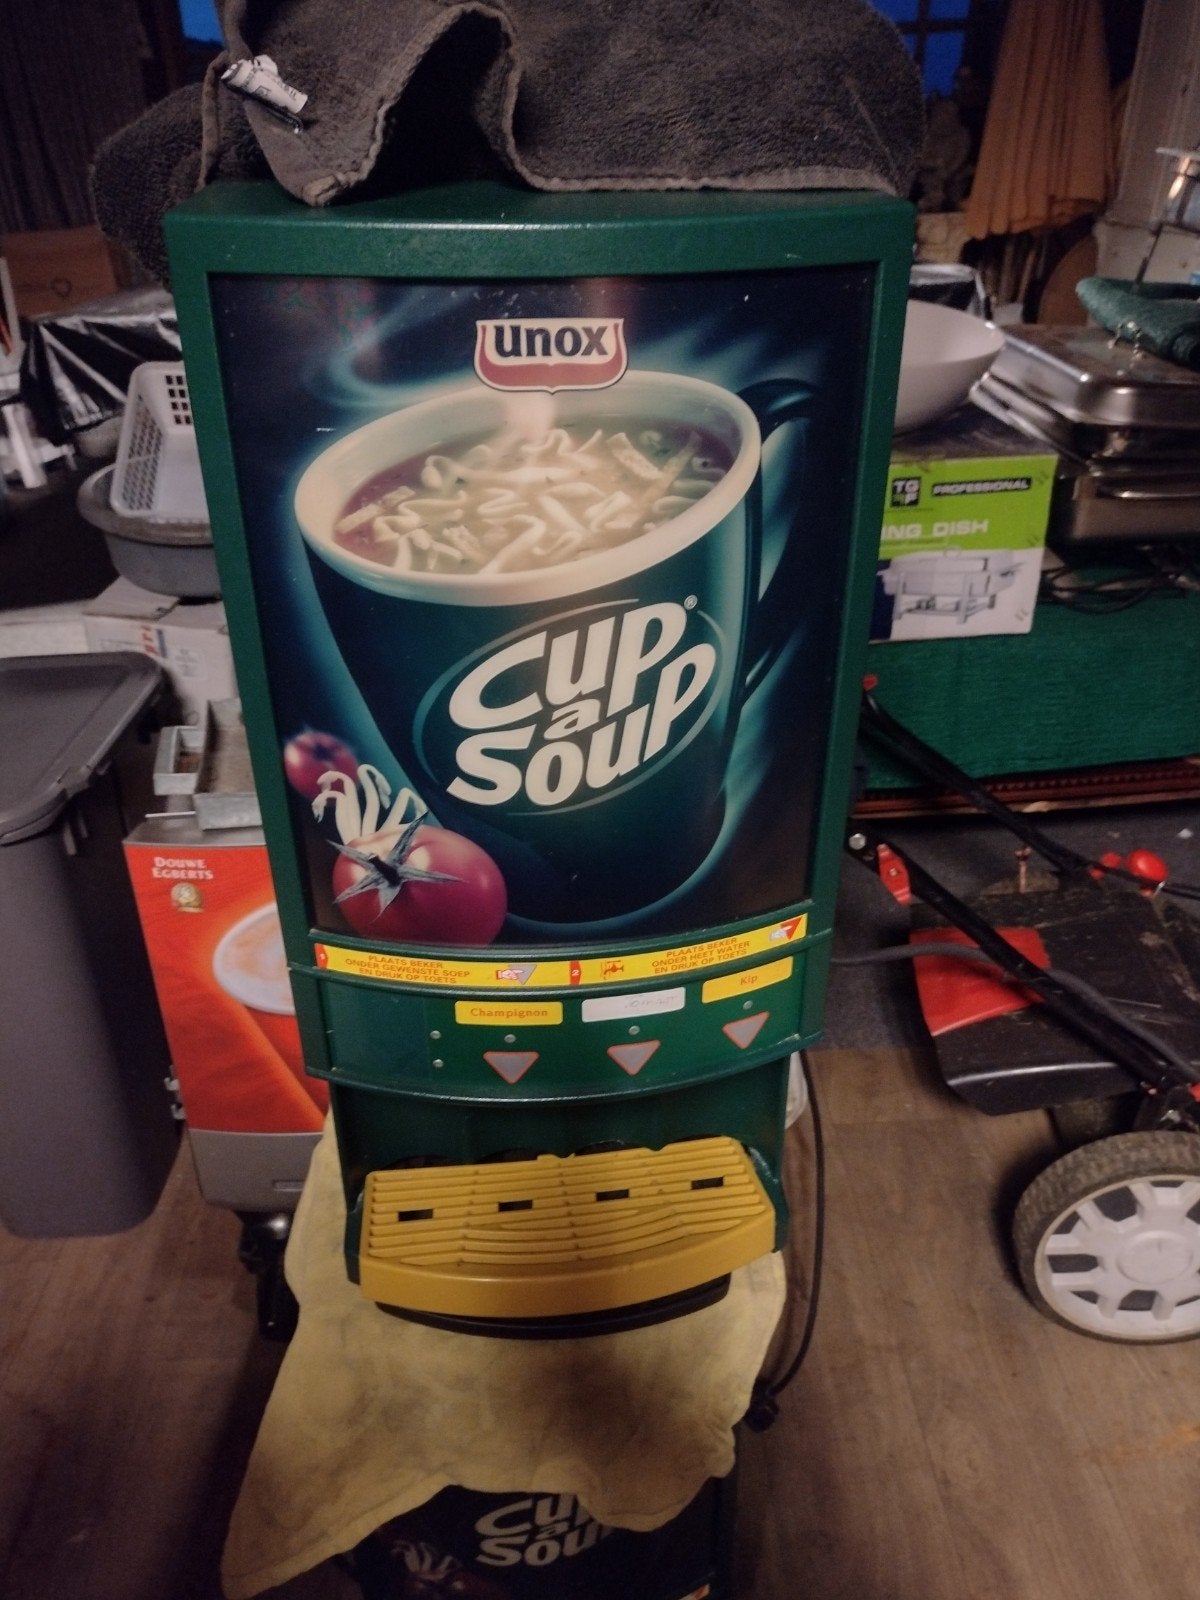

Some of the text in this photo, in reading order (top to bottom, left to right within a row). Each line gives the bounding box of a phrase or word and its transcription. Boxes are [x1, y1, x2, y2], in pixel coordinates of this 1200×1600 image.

[932, 478, 1030, 496] PROFESSIONAL
[933, 520, 989, 537] DISH
[543, 698, 601, 741] a
[652, 941, 750, 968] ONDER HEET WATER
[666, 938, 737, 957] PLAATS BEKER
[345, 958, 471, 978] ONDER GEWENSTE SOEP
[368, 954, 444, 969] PLAATS BEKER
[654, 949, 748, 975] EN DRUK OP TOETS
[358, 967, 458, 984] EN DRUK OP TOETS
[740, 975, 758, 986] Kip
[470, 1003, 549, 1019] Champignon
